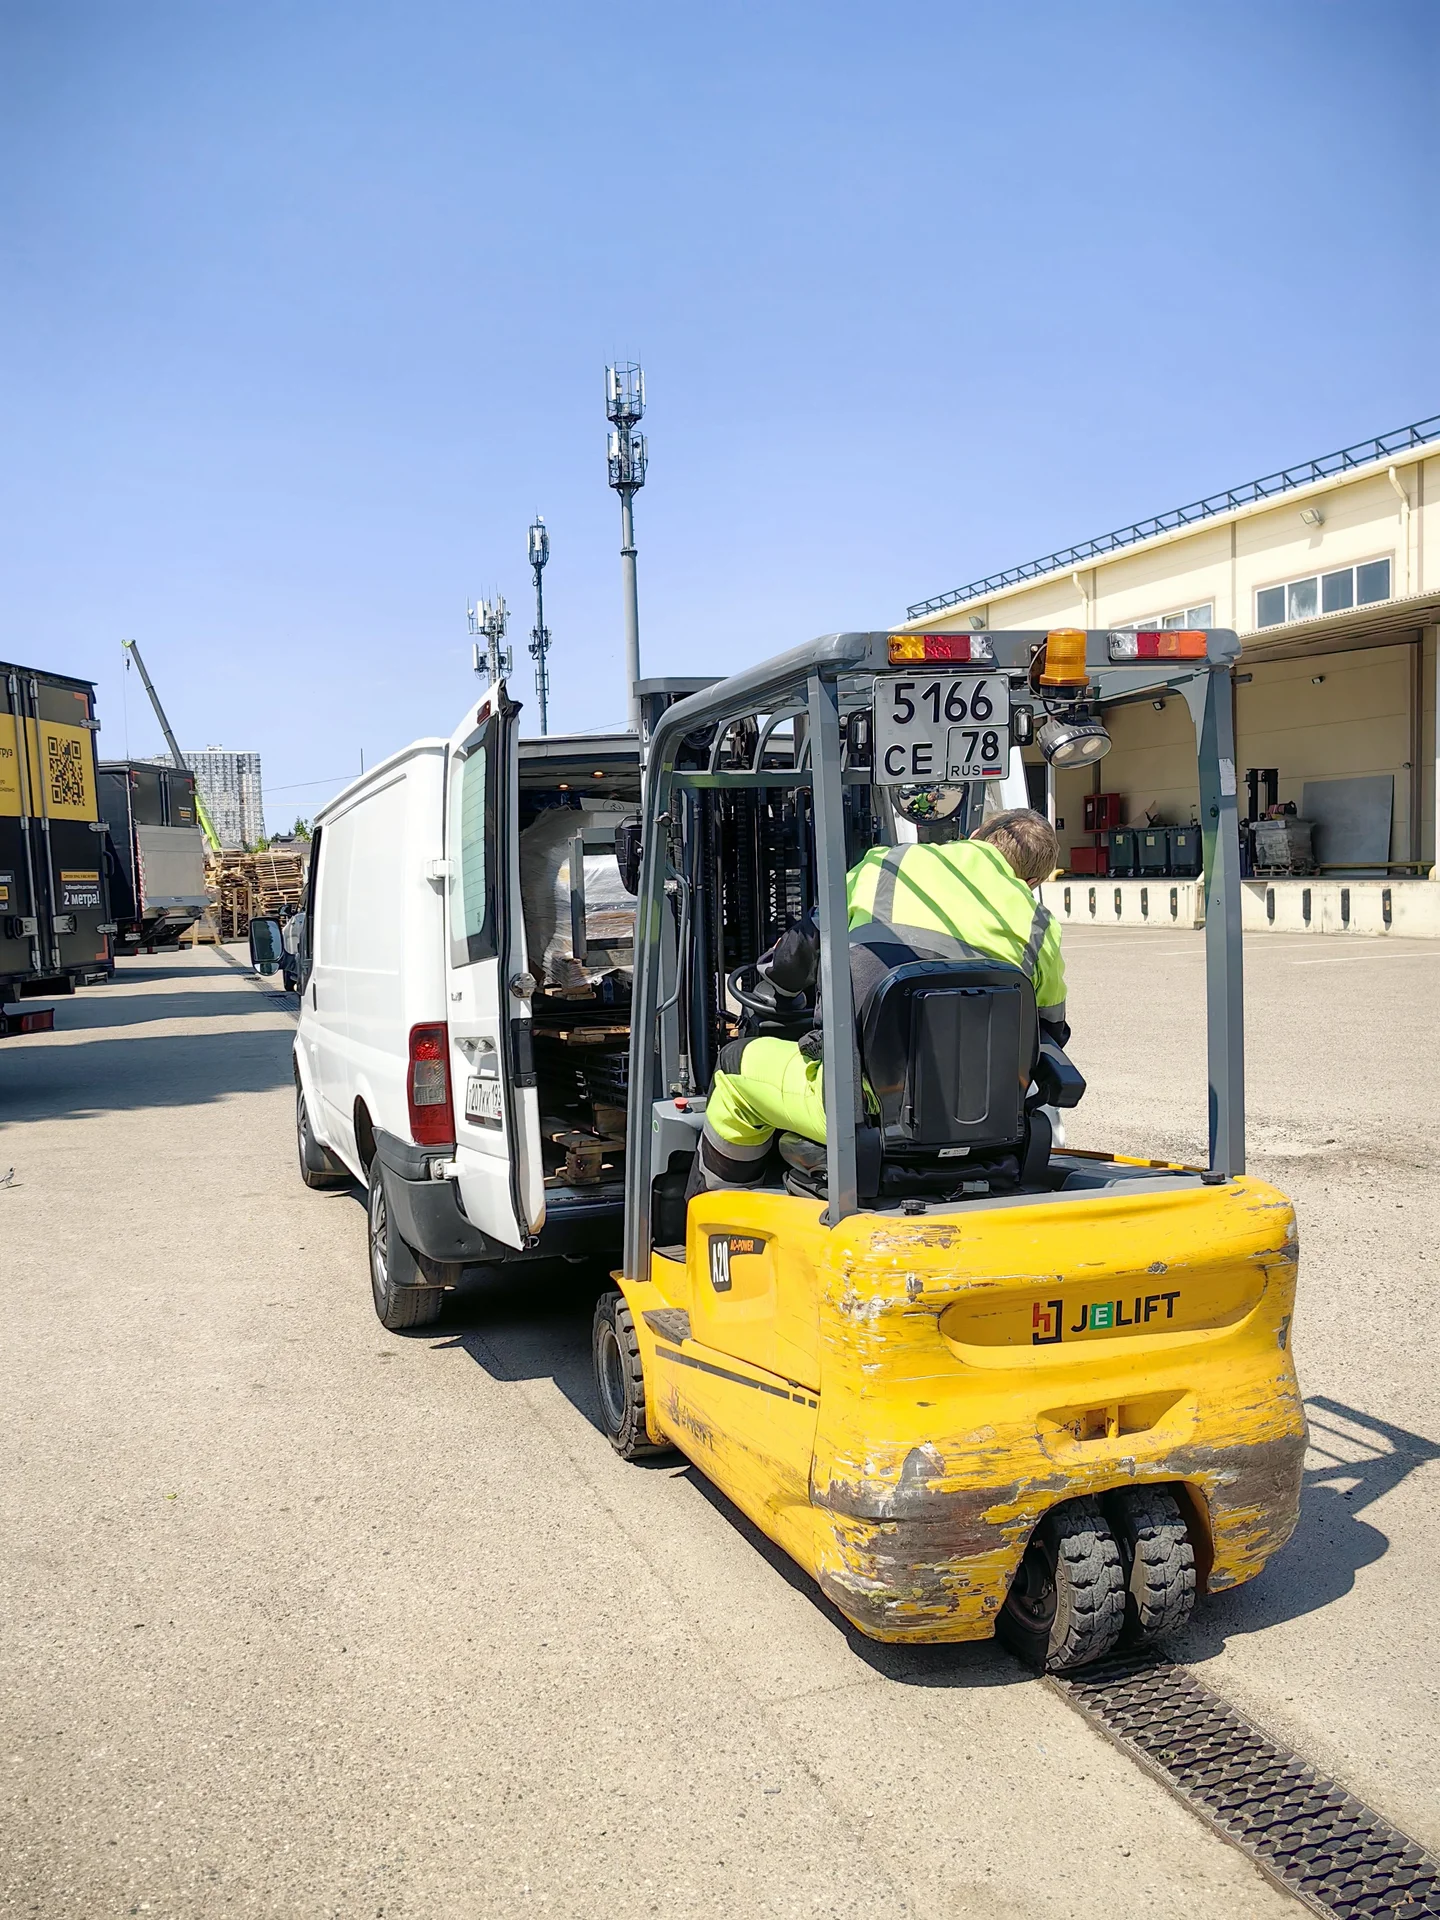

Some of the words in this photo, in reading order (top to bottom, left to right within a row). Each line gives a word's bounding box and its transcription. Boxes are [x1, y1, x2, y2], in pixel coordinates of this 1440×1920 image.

[892, 680, 993, 724] 5166
[884, 743, 933, 776] CE
[962, 731, 999, 762] 78
[951, 765, 980, 776] RUS
[64, 892, 70, 905] 2
[71, 891, 100, 907] метра!
[712, 1241, 729, 1283] A20
[1071, 1291, 1181, 1332] JELIFT
